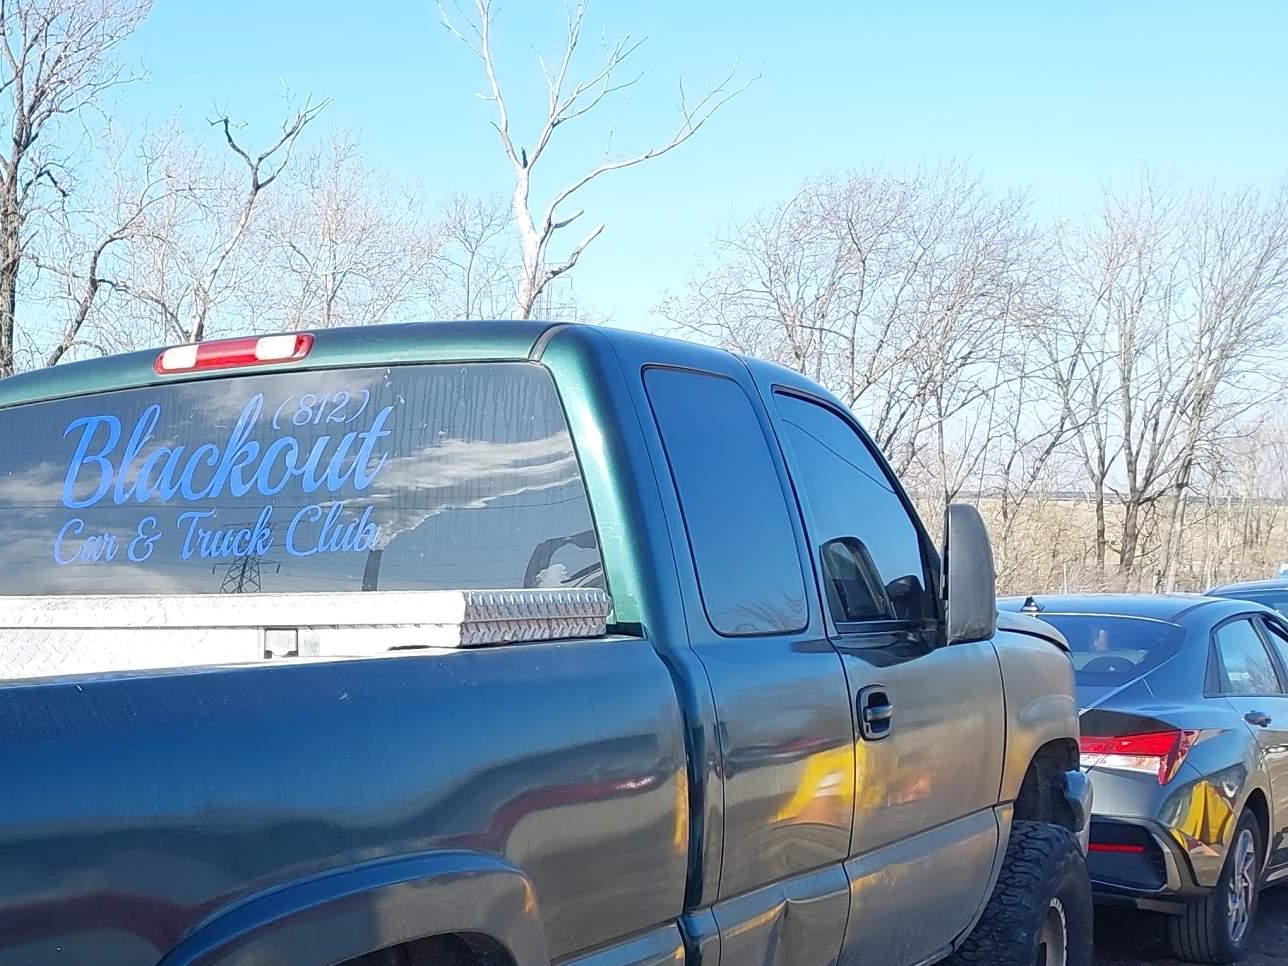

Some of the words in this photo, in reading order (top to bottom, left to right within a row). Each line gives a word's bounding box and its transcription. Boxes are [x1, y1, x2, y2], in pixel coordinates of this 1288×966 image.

[273, 389, 370, 430] (812)
[62, 392, 394, 509] Blackout
[54, 517, 120, 564] Car
[128, 516, 163, 562] &
[177, 505, 274, 560] Truck
[285, 501, 384, 557] Club
